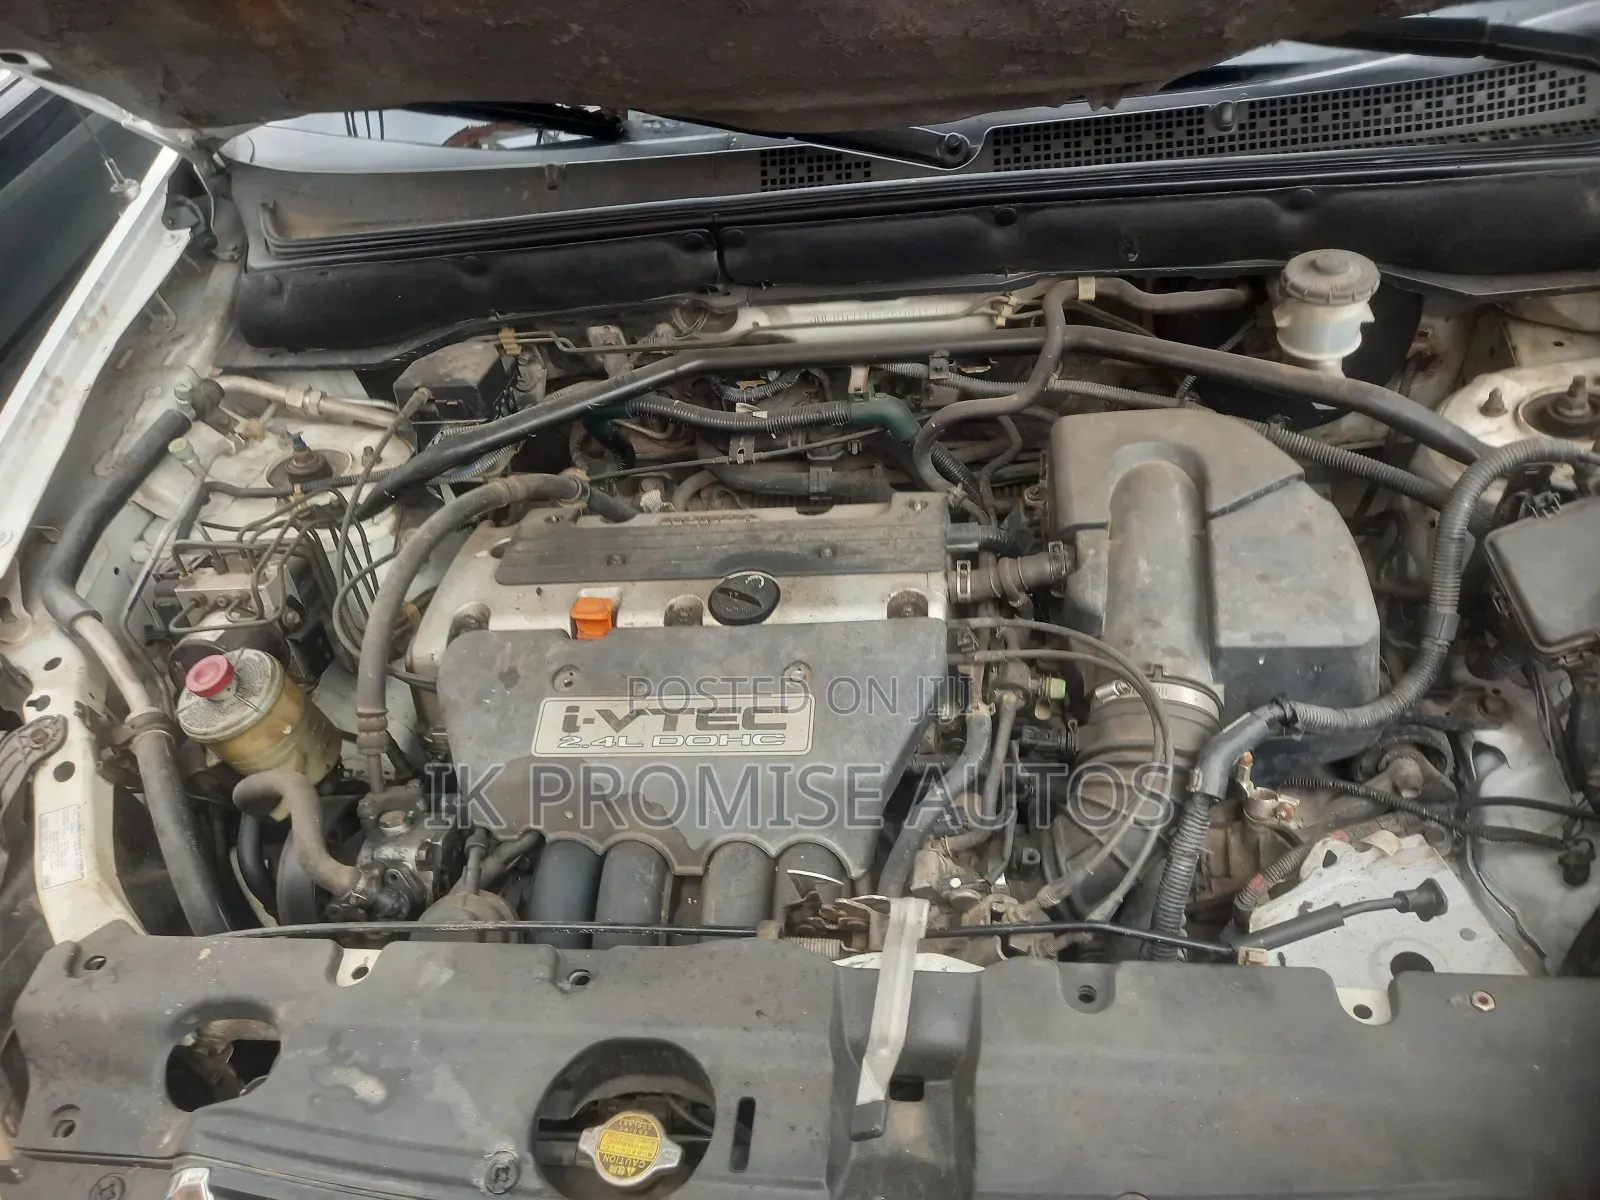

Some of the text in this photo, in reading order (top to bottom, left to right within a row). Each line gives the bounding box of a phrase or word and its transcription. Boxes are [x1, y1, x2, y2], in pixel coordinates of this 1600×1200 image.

[562, 705, 788, 733] i-VTEC
[557, 733, 786, 749] 2.4L DOHC
[602, 1154, 646, 1169] CAUTION
